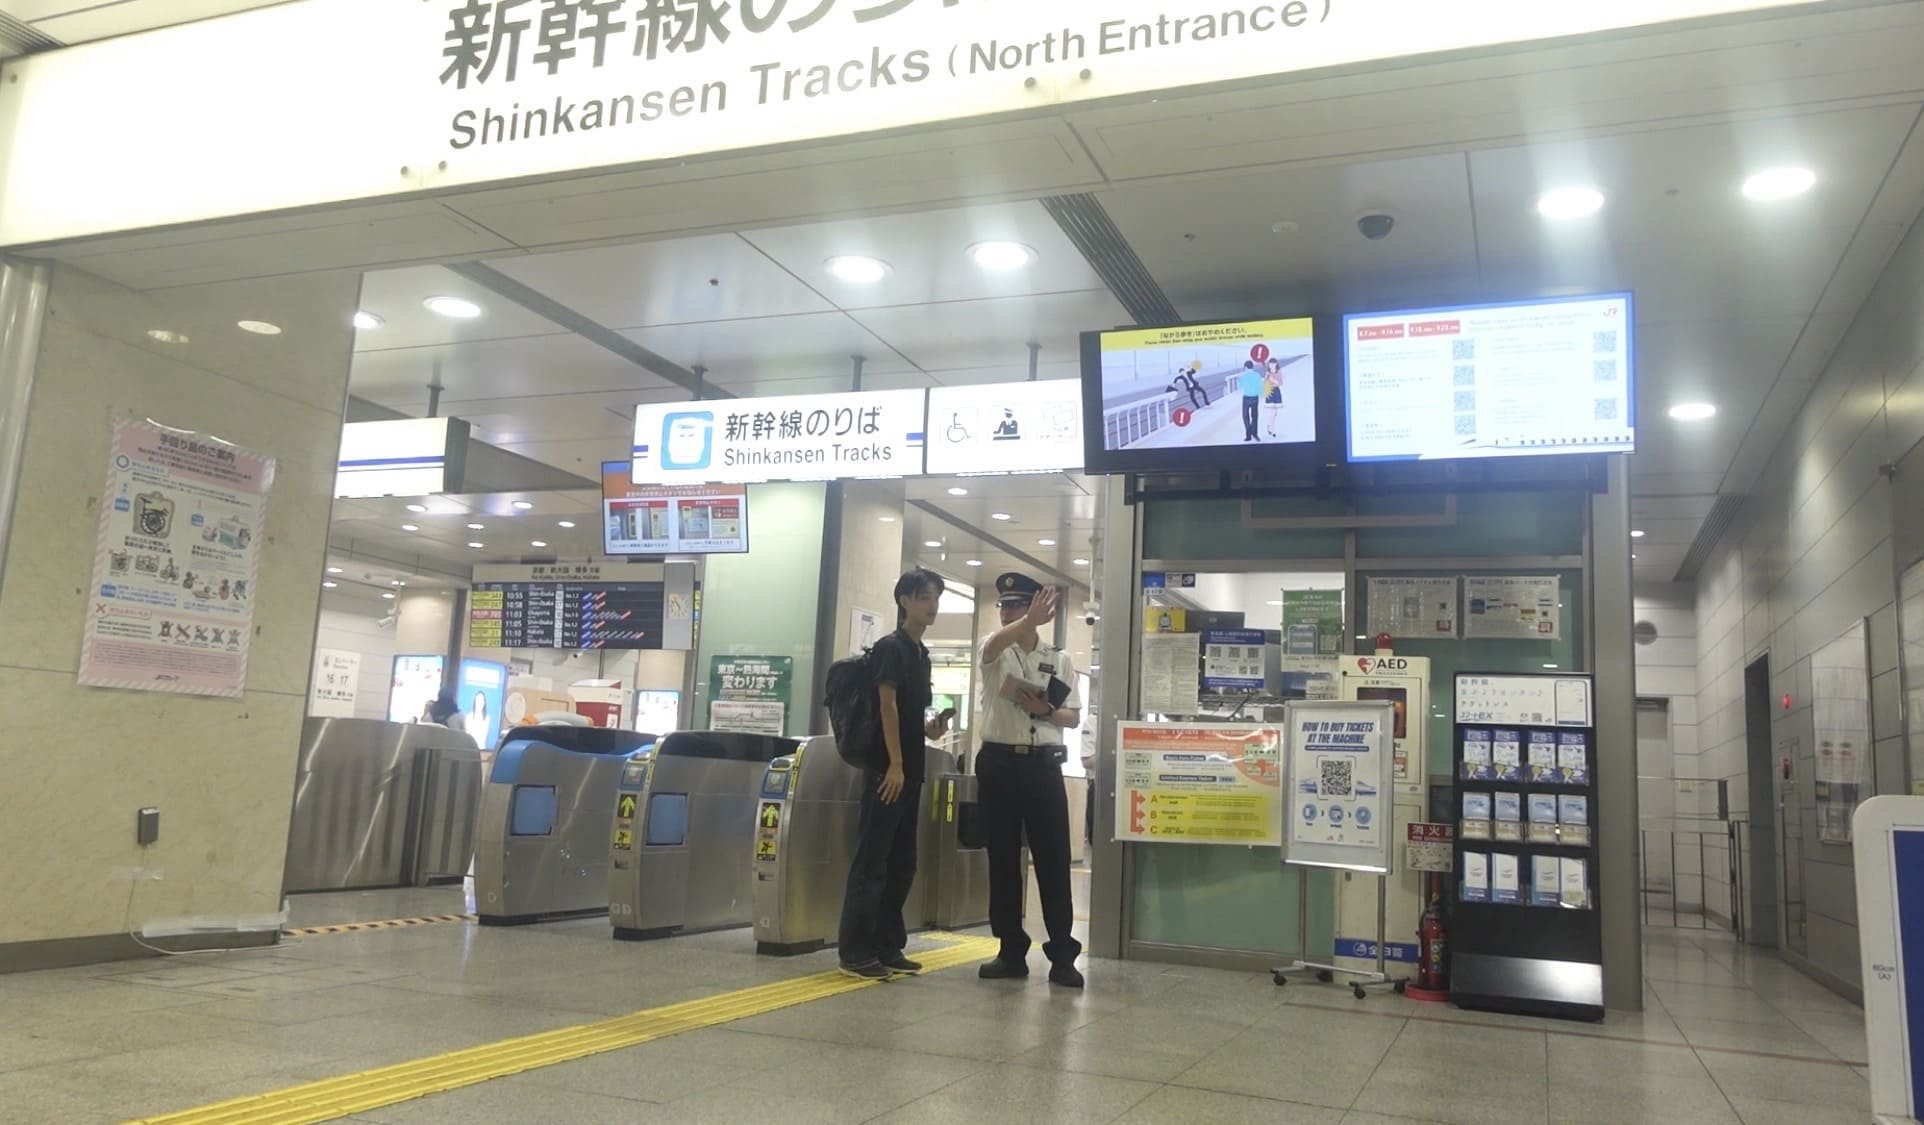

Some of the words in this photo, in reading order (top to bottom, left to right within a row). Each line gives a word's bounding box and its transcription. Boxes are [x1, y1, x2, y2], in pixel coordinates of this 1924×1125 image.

[450, 81, 727, 149] Shinkansen
[750, 46, 930, 105] Tracks
[725, 405, 882, 442] 新幹線のりば
[724, 446, 824, 466] Shinkansen
[832, 442, 892, 462] Tracks
[1376, 658, 1407, 669] AED
[722, 675, 778, 689] 変わります
[1302, 721, 1319, 732] HOW
[1320, 721, 1330, 732] TO
[1330, 722, 1345, 732] BUY
[1345, 722, 1375, 733] TICKETS
[1307, 733, 1317, 743] AT
[1318, 733, 1332, 744] THE
[1332, 733, 1366, 745] MACHINE
[1150, 795, 1157, 803] A
[1150, 811, 1156, 819] B
[1150, 825, 1157, 834] C
